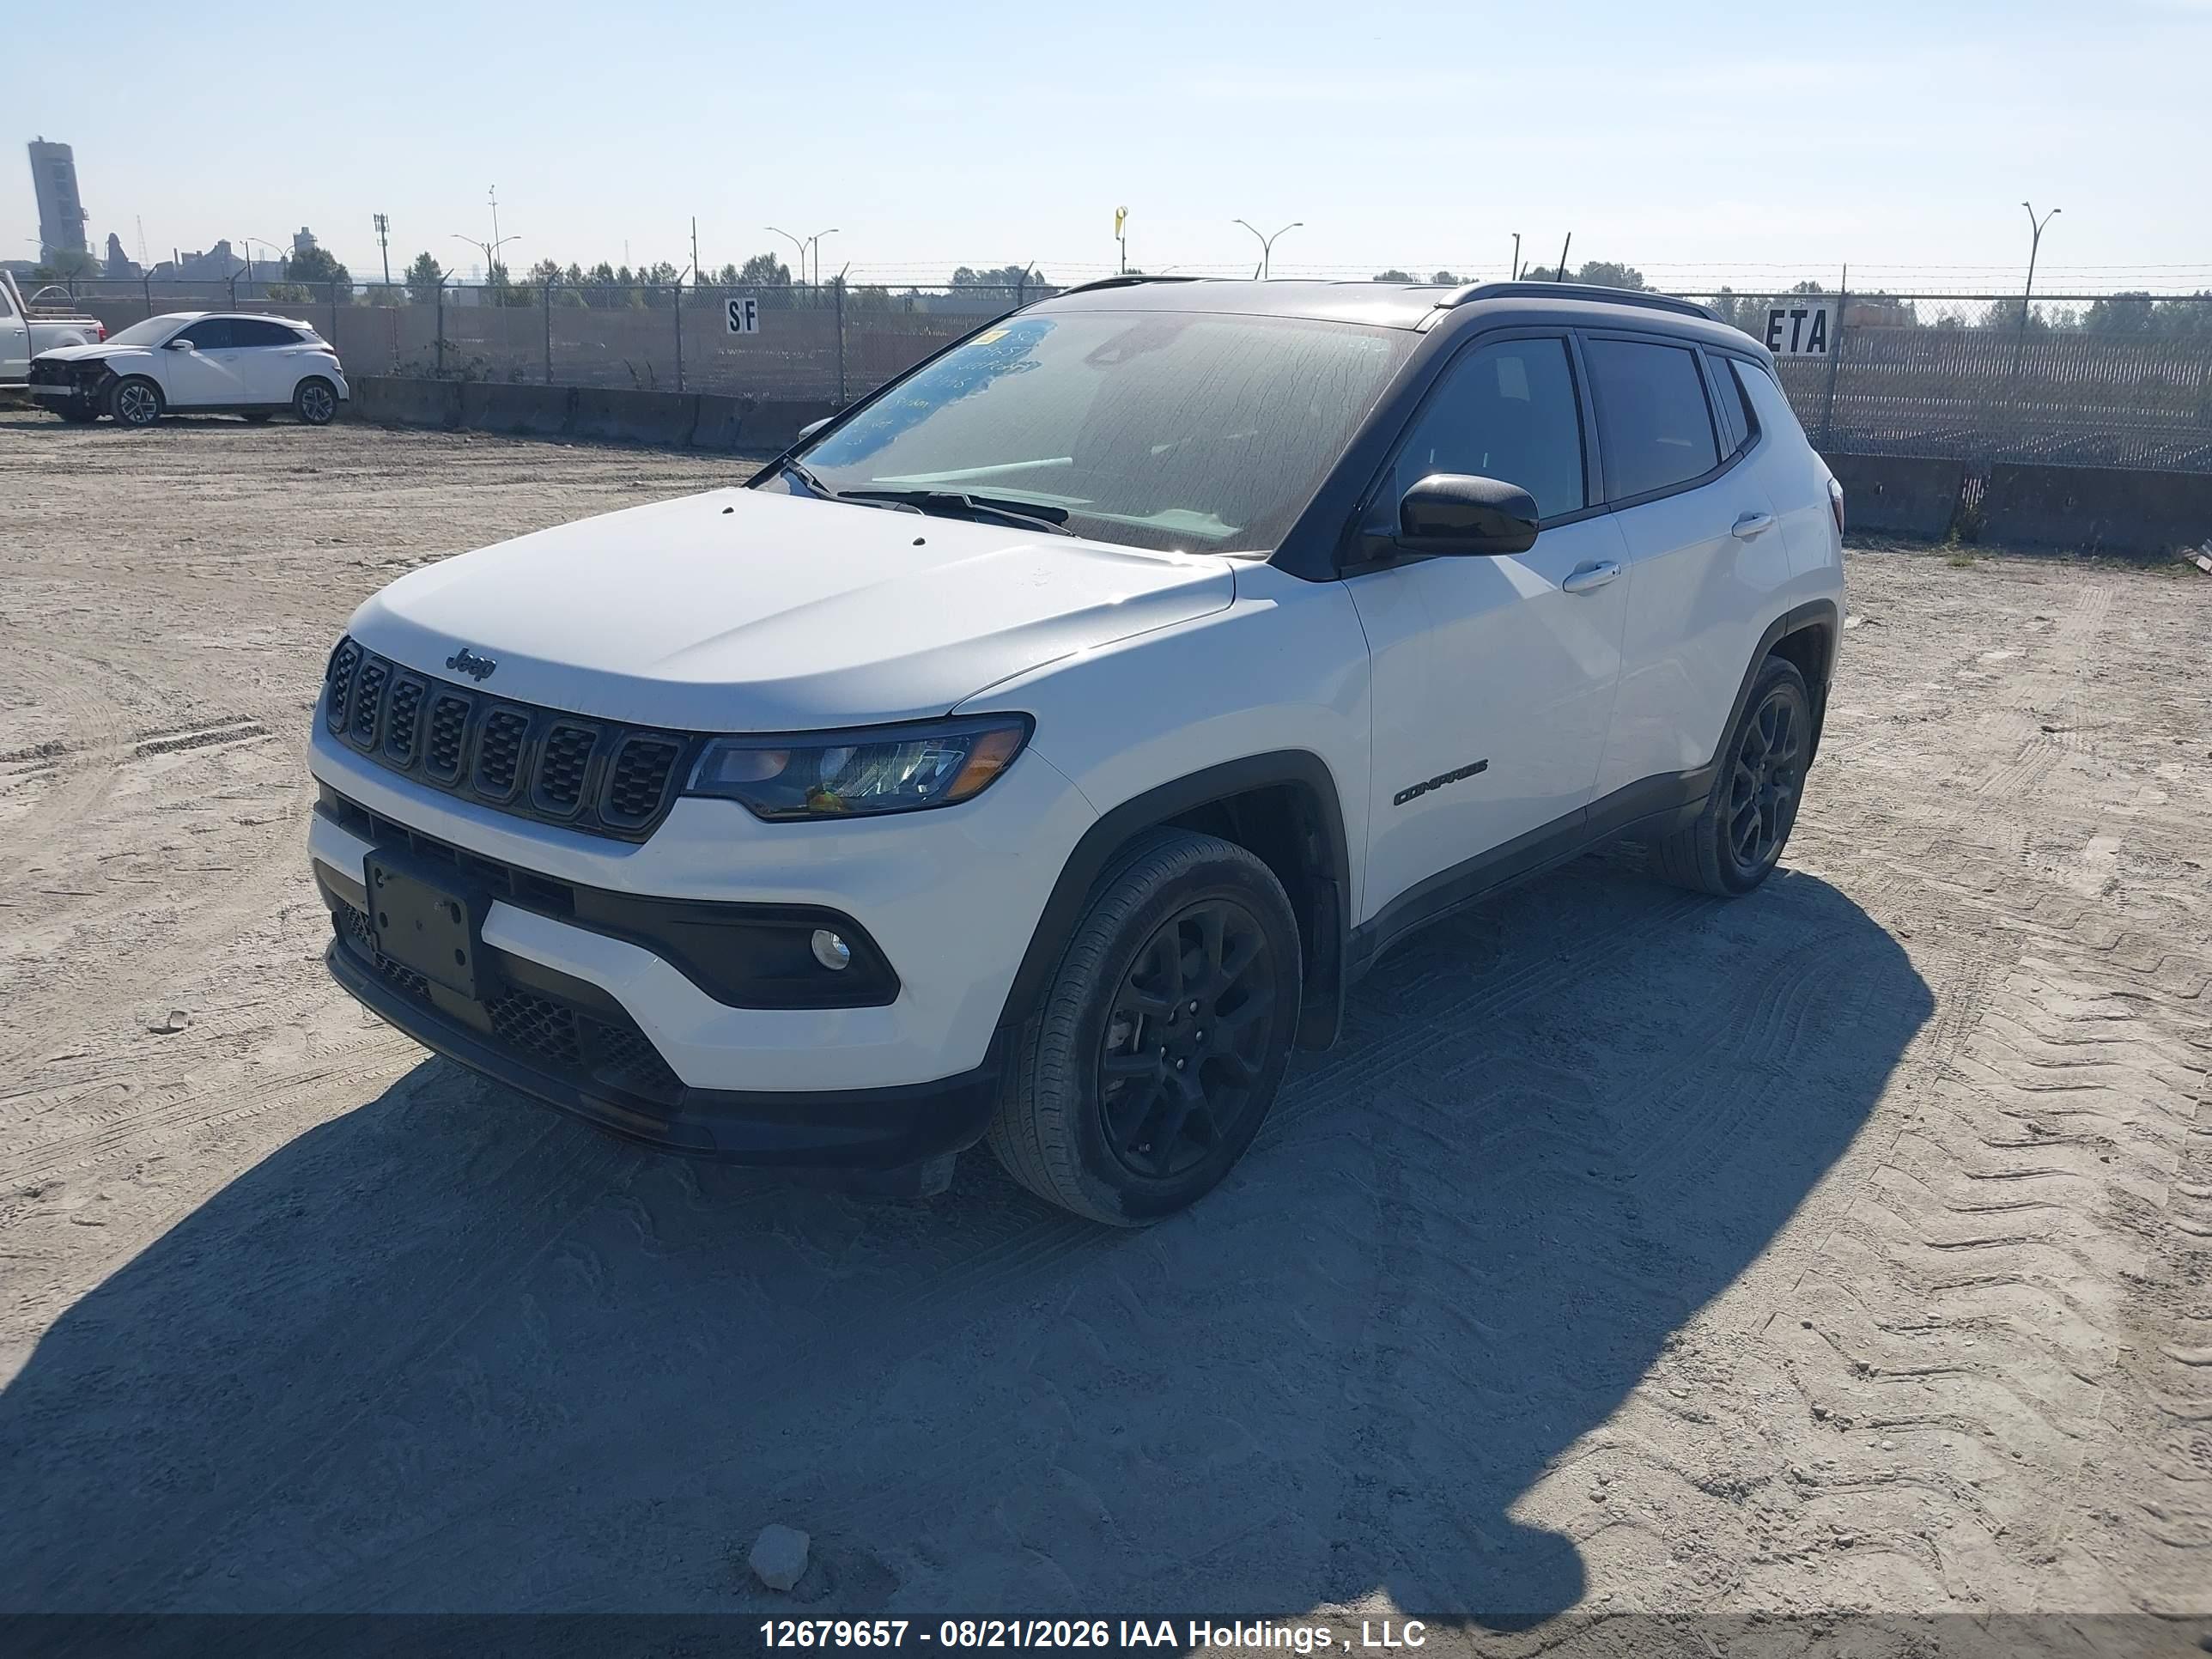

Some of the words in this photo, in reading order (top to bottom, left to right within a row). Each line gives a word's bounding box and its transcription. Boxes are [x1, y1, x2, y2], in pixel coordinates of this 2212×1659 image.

[729, 301, 755, 331] SF
[1766, 309, 1826, 353] ETA
[446, 647, 497, 683] Jeep
